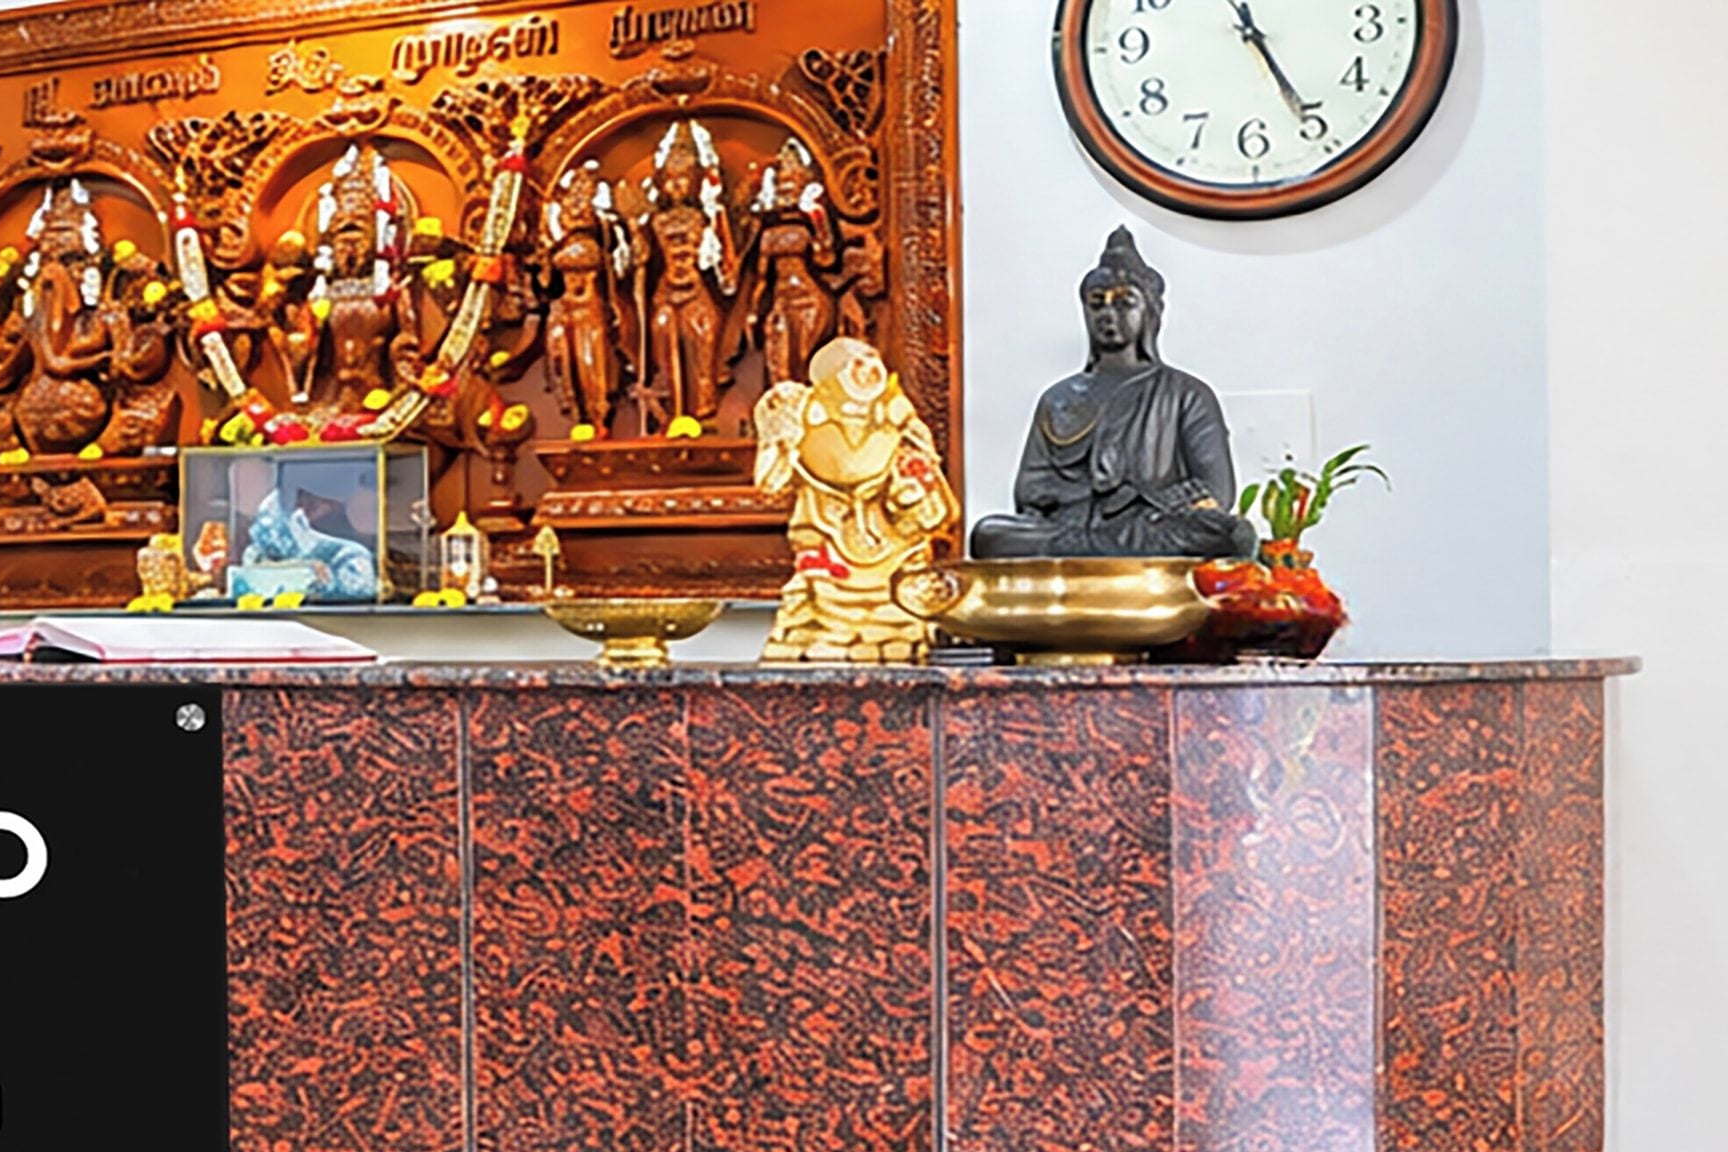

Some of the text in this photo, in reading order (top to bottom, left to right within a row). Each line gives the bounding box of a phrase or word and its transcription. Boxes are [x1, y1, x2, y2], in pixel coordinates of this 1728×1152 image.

[1353, 5, 1384, 42] 3
[1118, 27, 1150, 63] 9
[1339, 56, 1370, 92] 4
[1139, 78, 1168, 116] 8
[1183, 112, 1210, 150] 7
[1237, 118, 1270, 160] 6
[1299, 101, 1328, 141] 5
